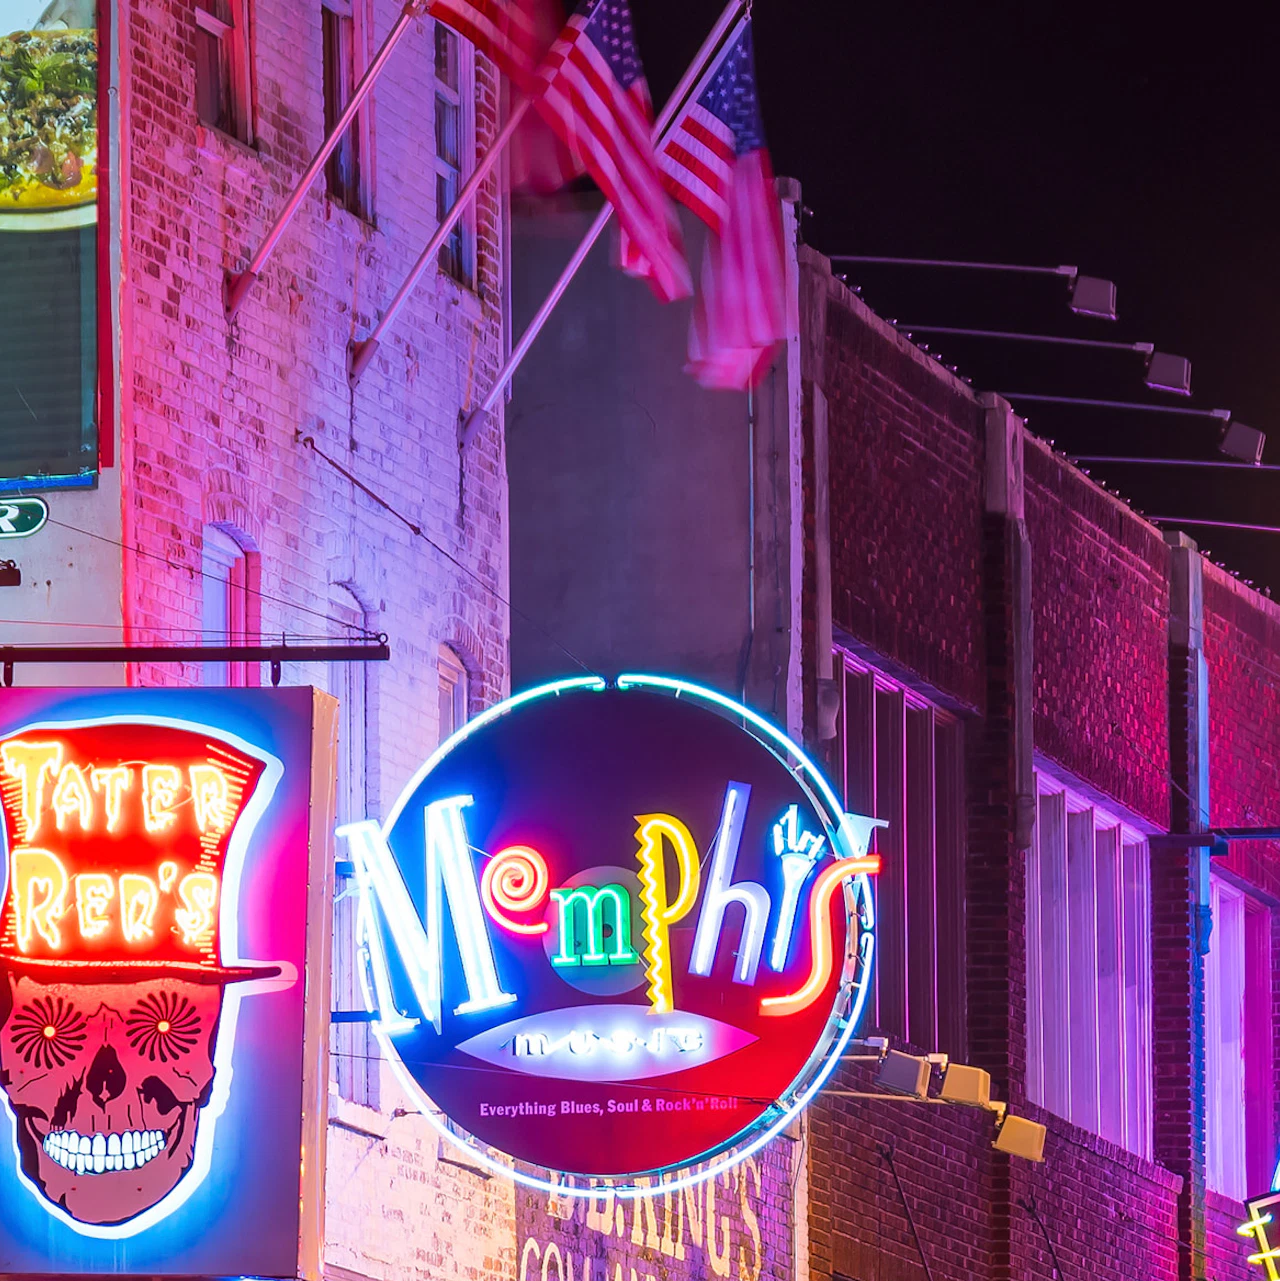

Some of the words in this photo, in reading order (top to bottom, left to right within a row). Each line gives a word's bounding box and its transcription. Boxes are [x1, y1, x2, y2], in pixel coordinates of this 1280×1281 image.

[0, 738, 232, 842] TATER
[9, 848, 219, 952] RED'S
[335, 780, 882, 1036] Memphis
[480, 1101, 556, 1118] Everything
[561, 1100, 603, 1116] Blues,
[607, 1098, 639, 1113] Soul
[642, 1099, 652, 1112] &
